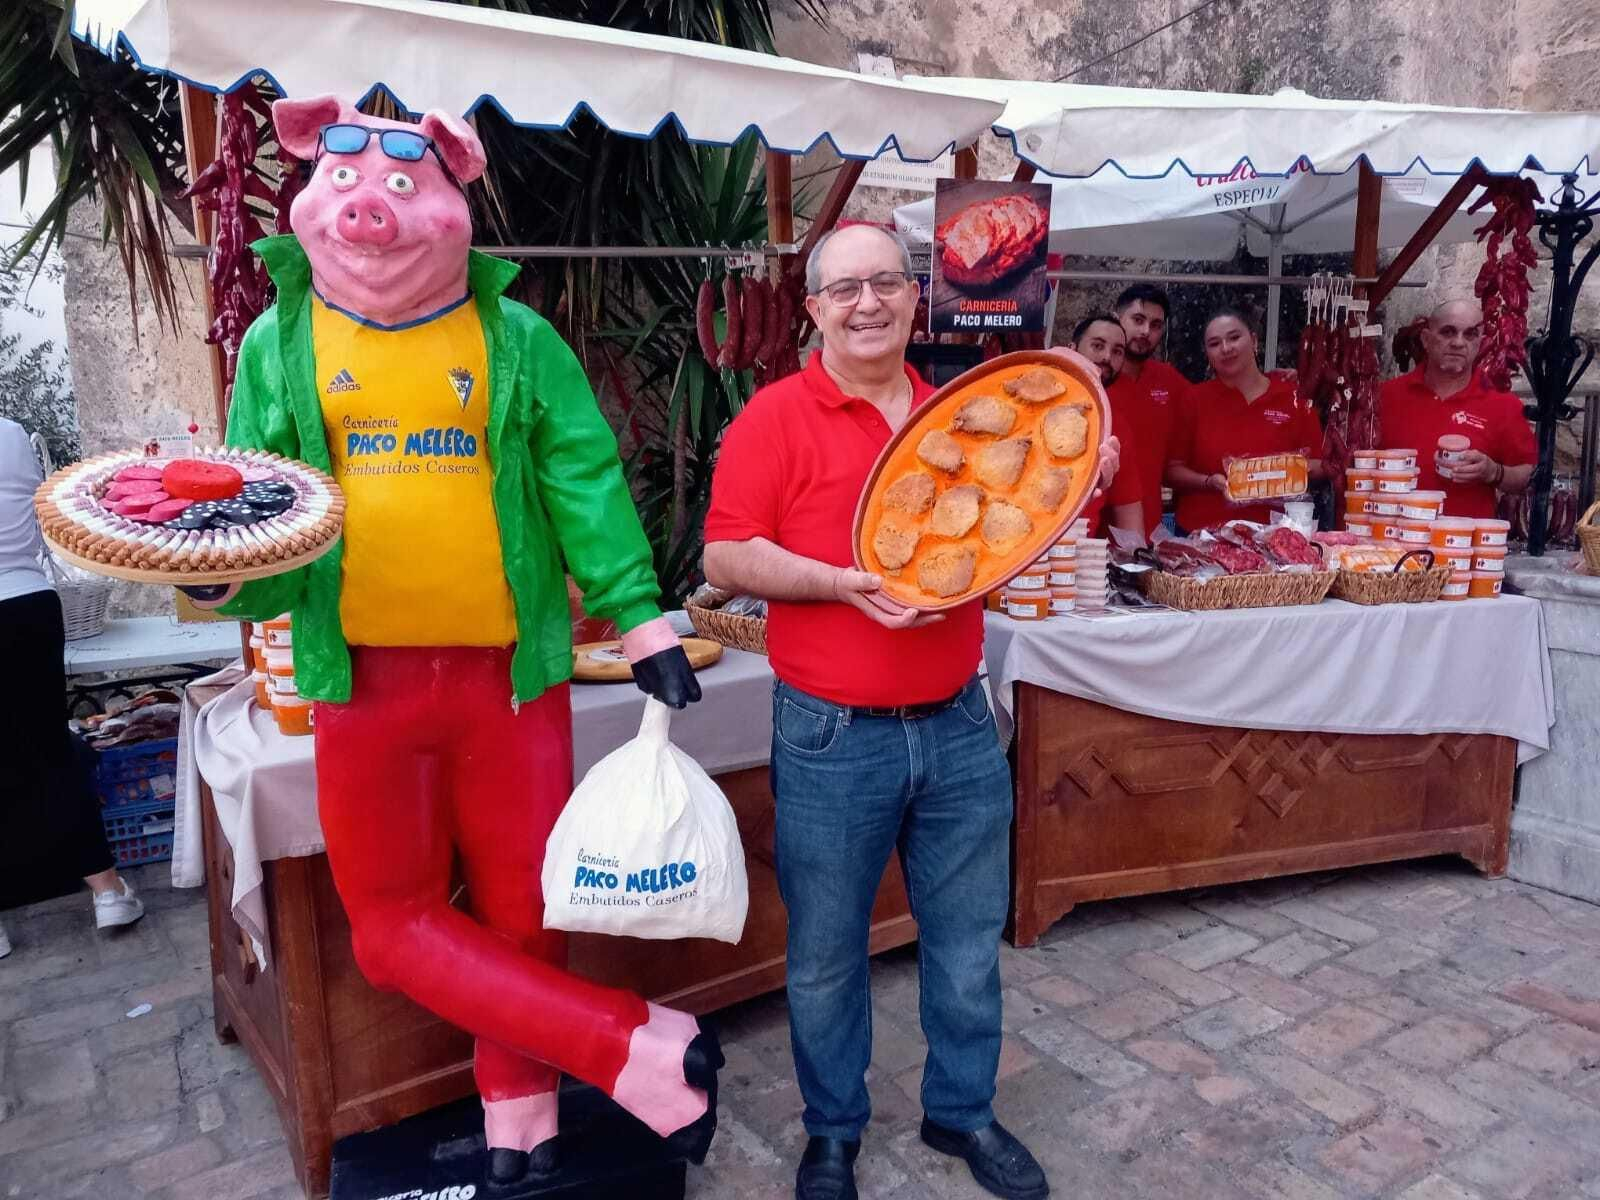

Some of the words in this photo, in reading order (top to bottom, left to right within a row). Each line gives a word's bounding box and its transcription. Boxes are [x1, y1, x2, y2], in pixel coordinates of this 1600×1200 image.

[954, 315, 981, 327] PACO
[984, 315, 1022, 327] MELERO
[326, 382, 361, 394] adidas
[347, 432, 397, 458] PACO
[404, 427, 477, 458] MELERO
[344, 460, 420, 477] Embutidos
[425, 458, 480, 475] Caseros
[574, 866, 618, 889] PACO
[625, 861, 697, 893] MELERO
[569, 892, 641, 907] Embutidos
[645, 887, 698, 906] Caseros
